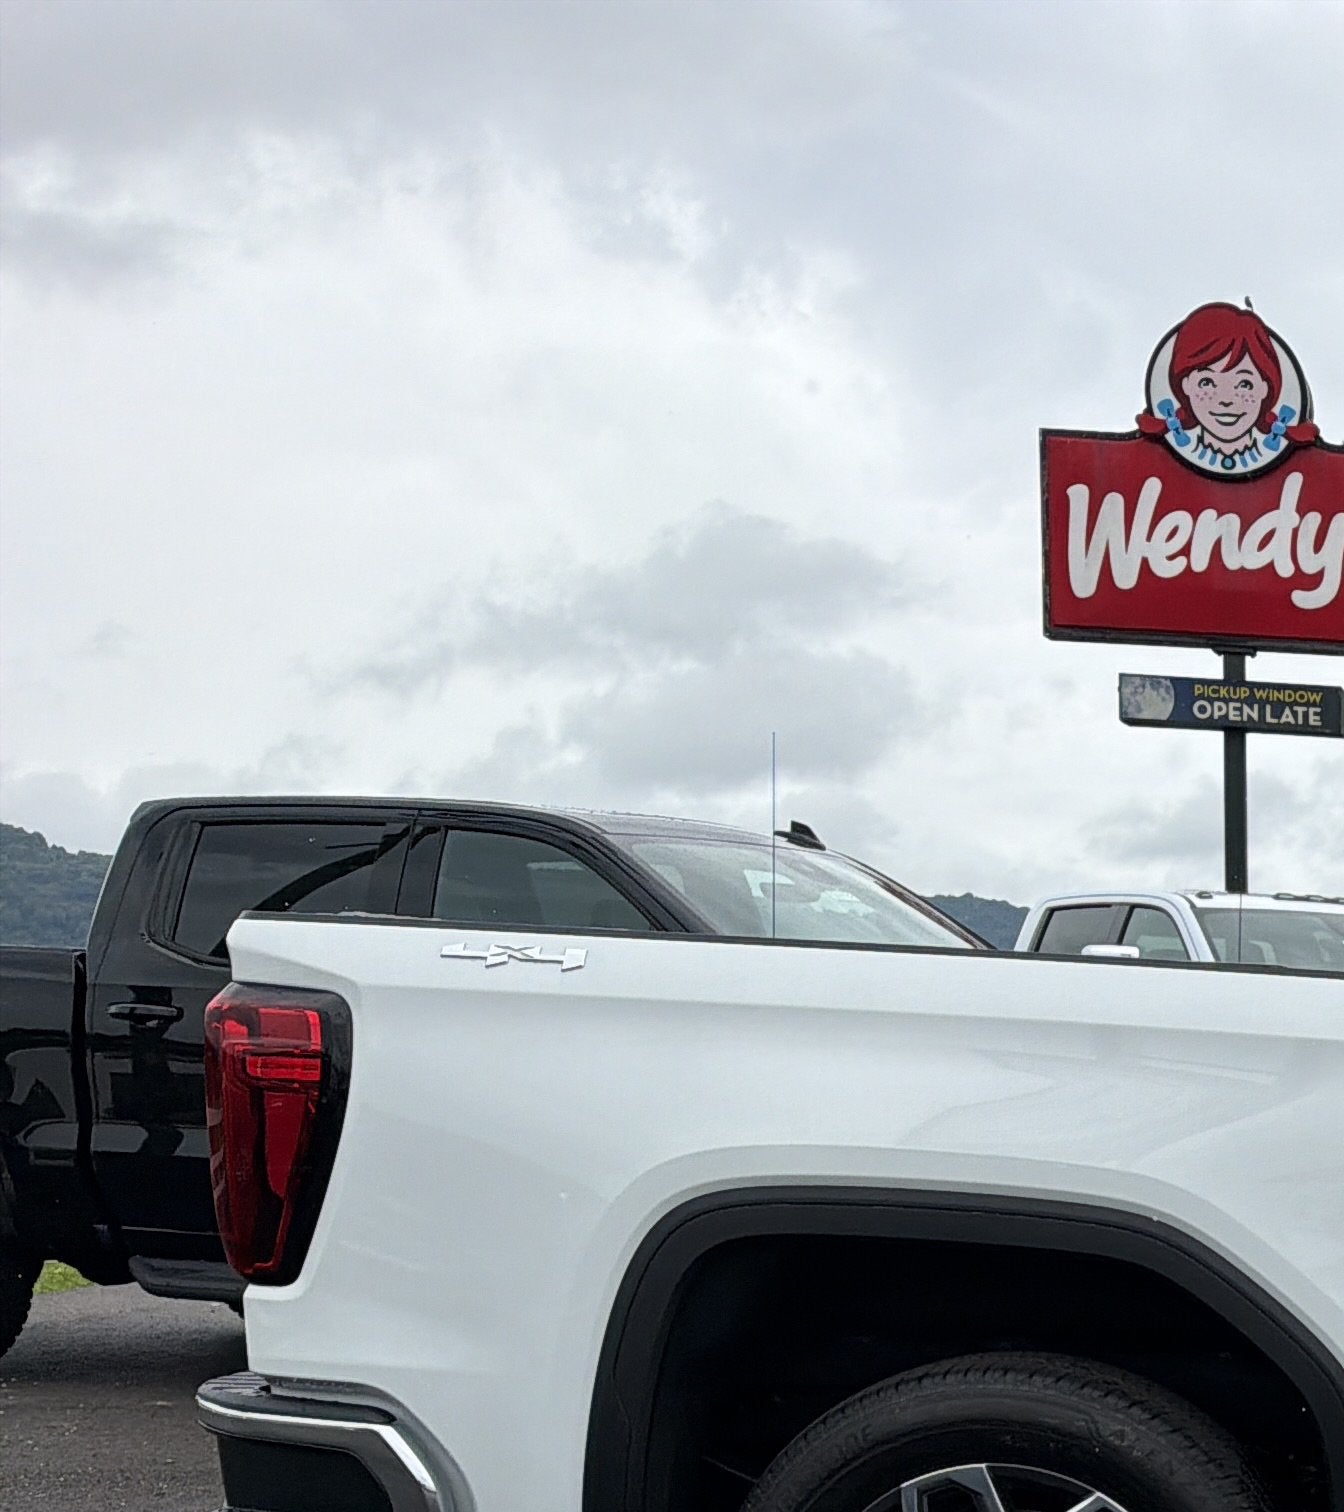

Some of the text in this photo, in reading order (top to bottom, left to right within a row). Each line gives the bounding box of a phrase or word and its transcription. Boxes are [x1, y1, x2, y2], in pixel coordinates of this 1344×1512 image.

[1193, 684, 1324, 705] PICKUP WINDOW
[1192, 699, 1323, 726] OPEN LATE
